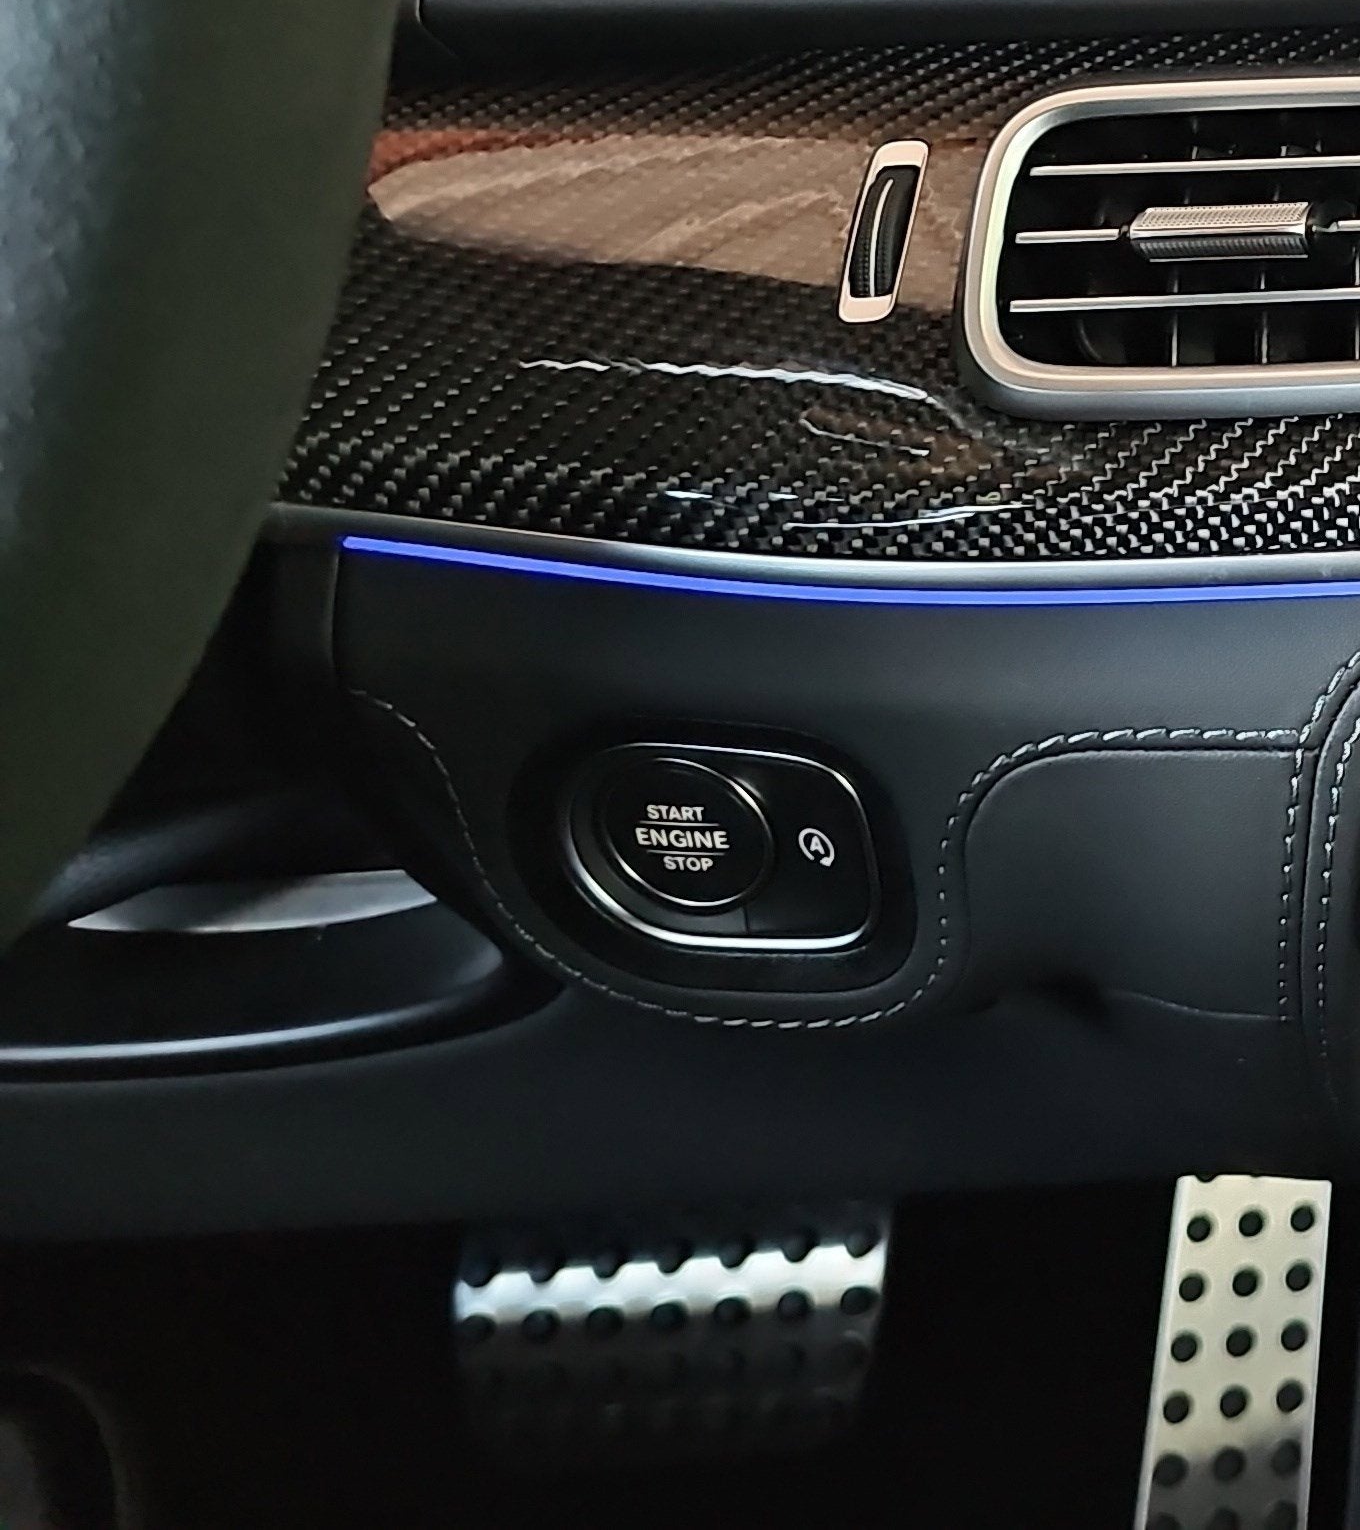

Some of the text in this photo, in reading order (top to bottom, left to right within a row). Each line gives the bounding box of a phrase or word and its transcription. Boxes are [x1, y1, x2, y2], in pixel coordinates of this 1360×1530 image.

[646, 804, 705, 822] START
[635, 827, 730, 849] ENGINE
[662, 856, 714, 872] STOP
